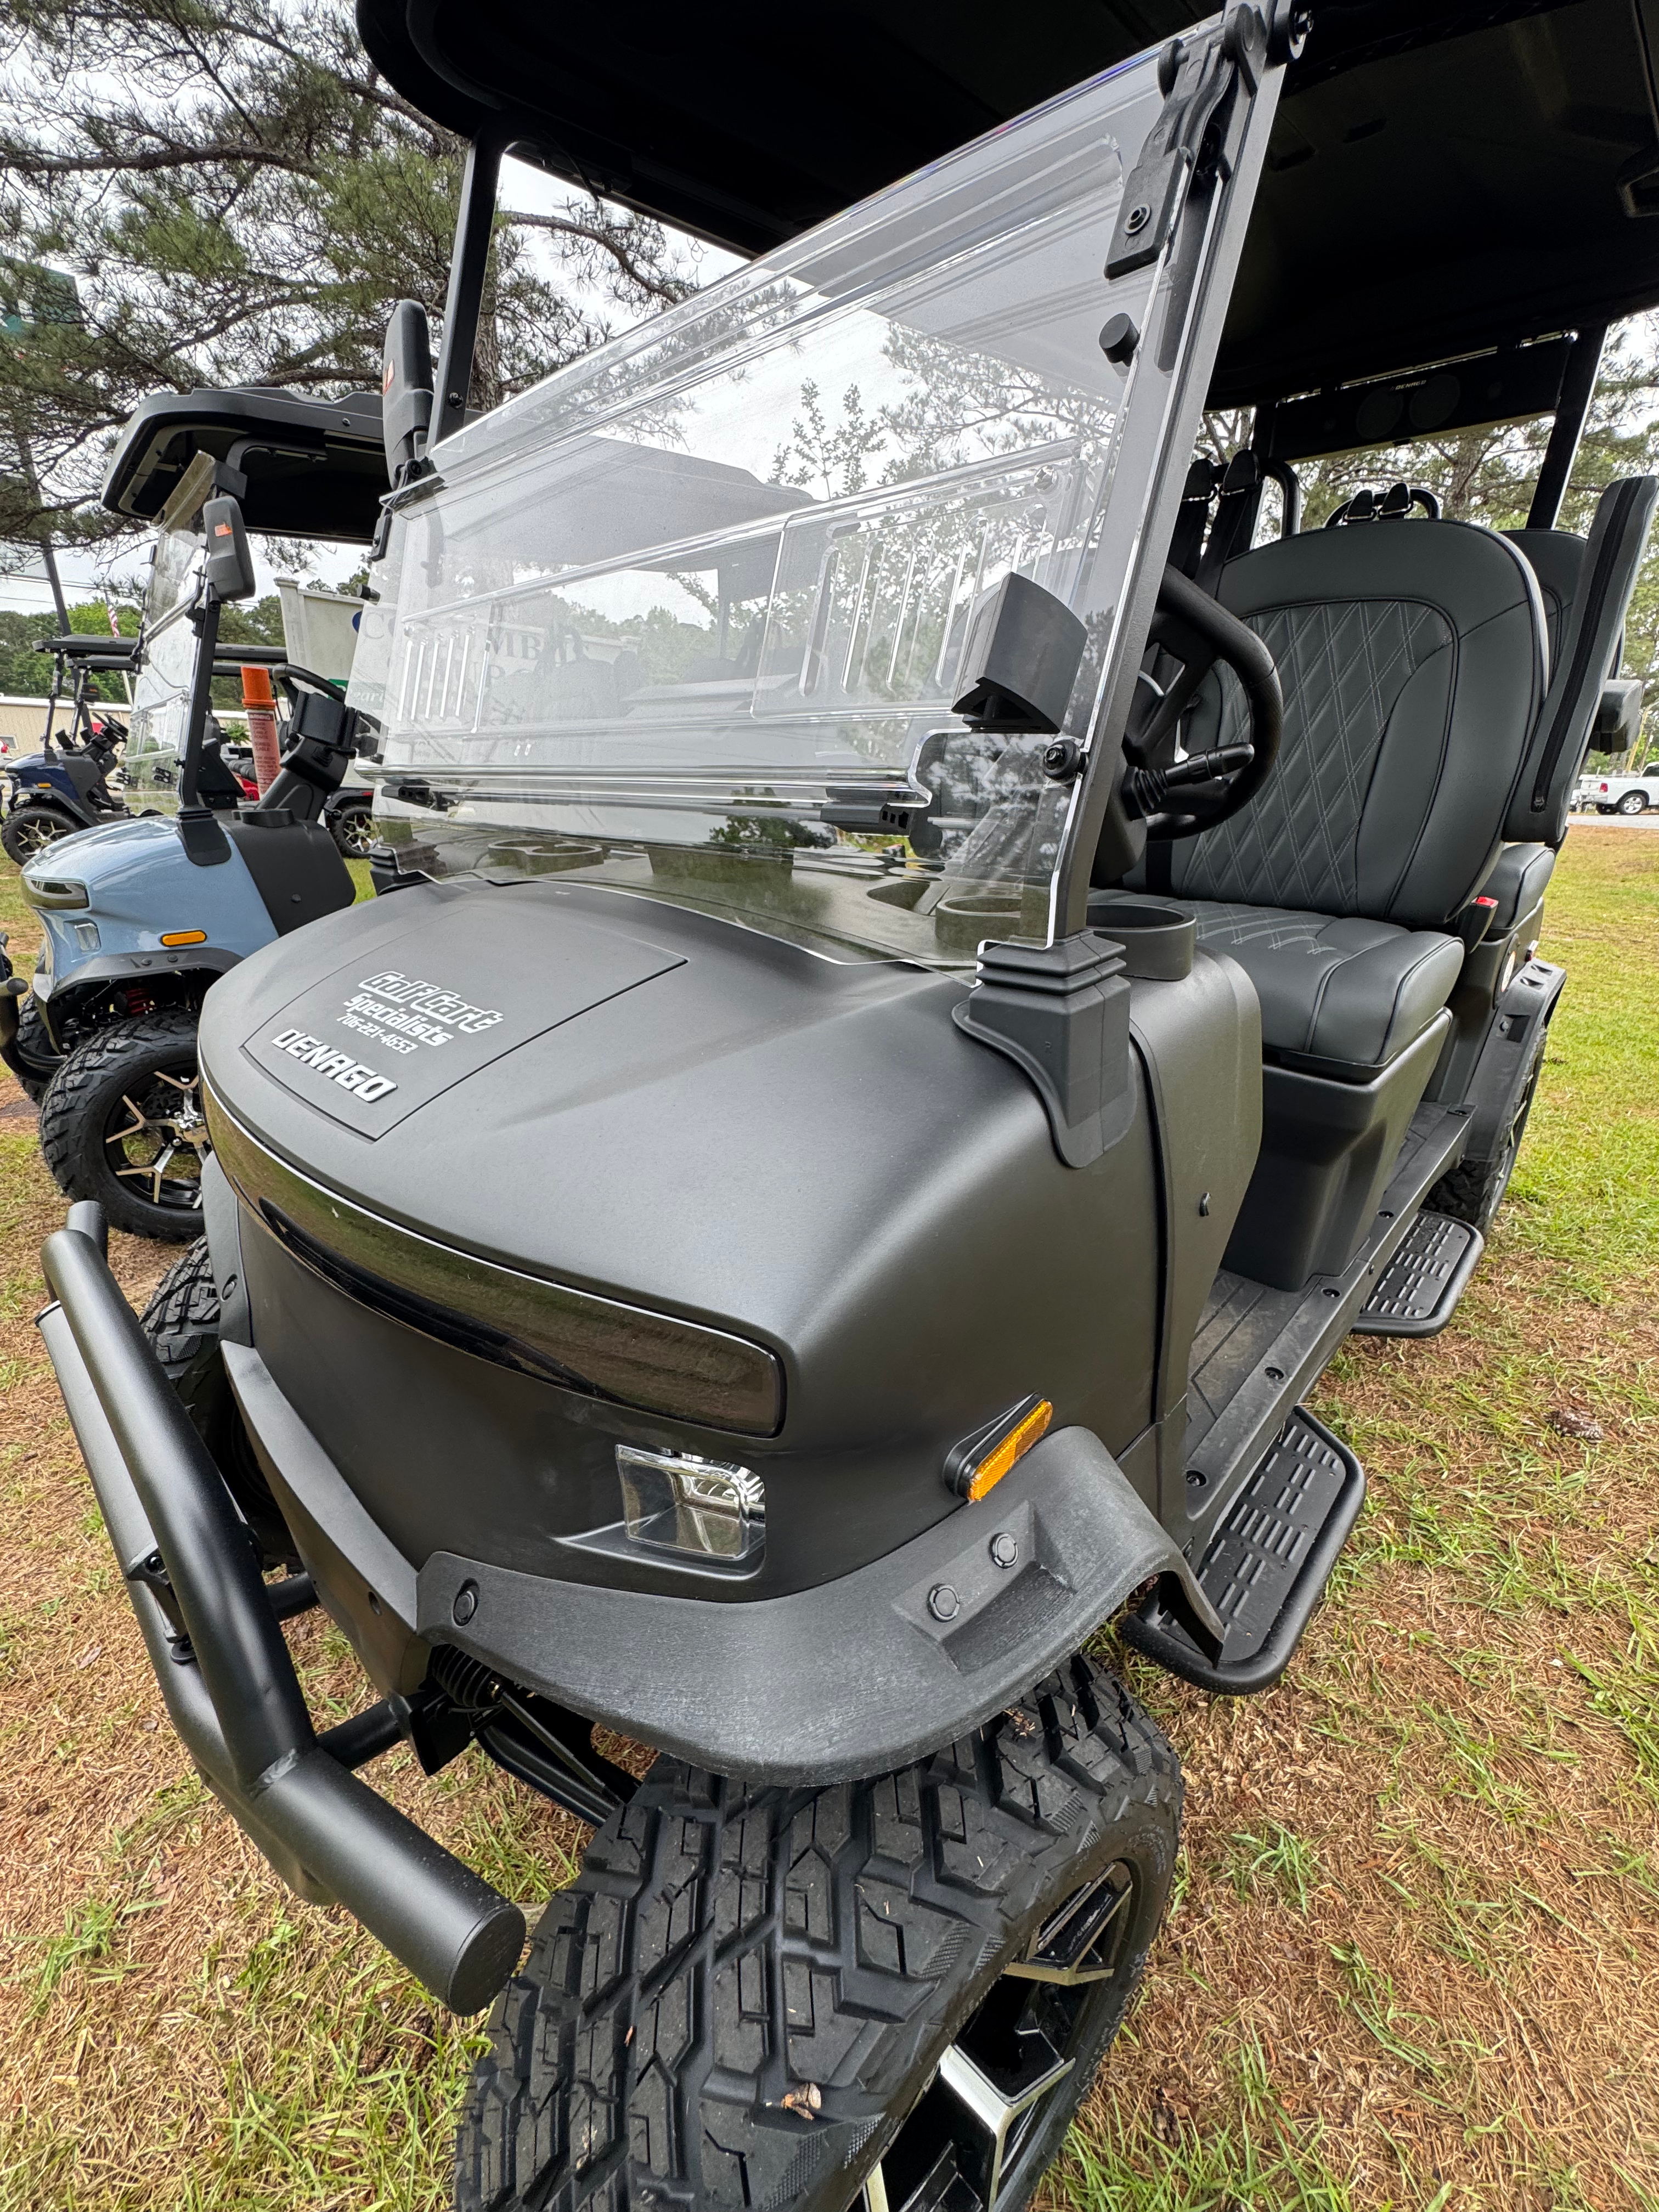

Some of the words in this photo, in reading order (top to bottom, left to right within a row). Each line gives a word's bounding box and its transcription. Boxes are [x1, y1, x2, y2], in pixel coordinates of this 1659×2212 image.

[336, 1013, 419, 1054] 706-221-4653
[343, 992, 454, 1046] Specialists
[271, 1028, 397, 1102] DENAGO
